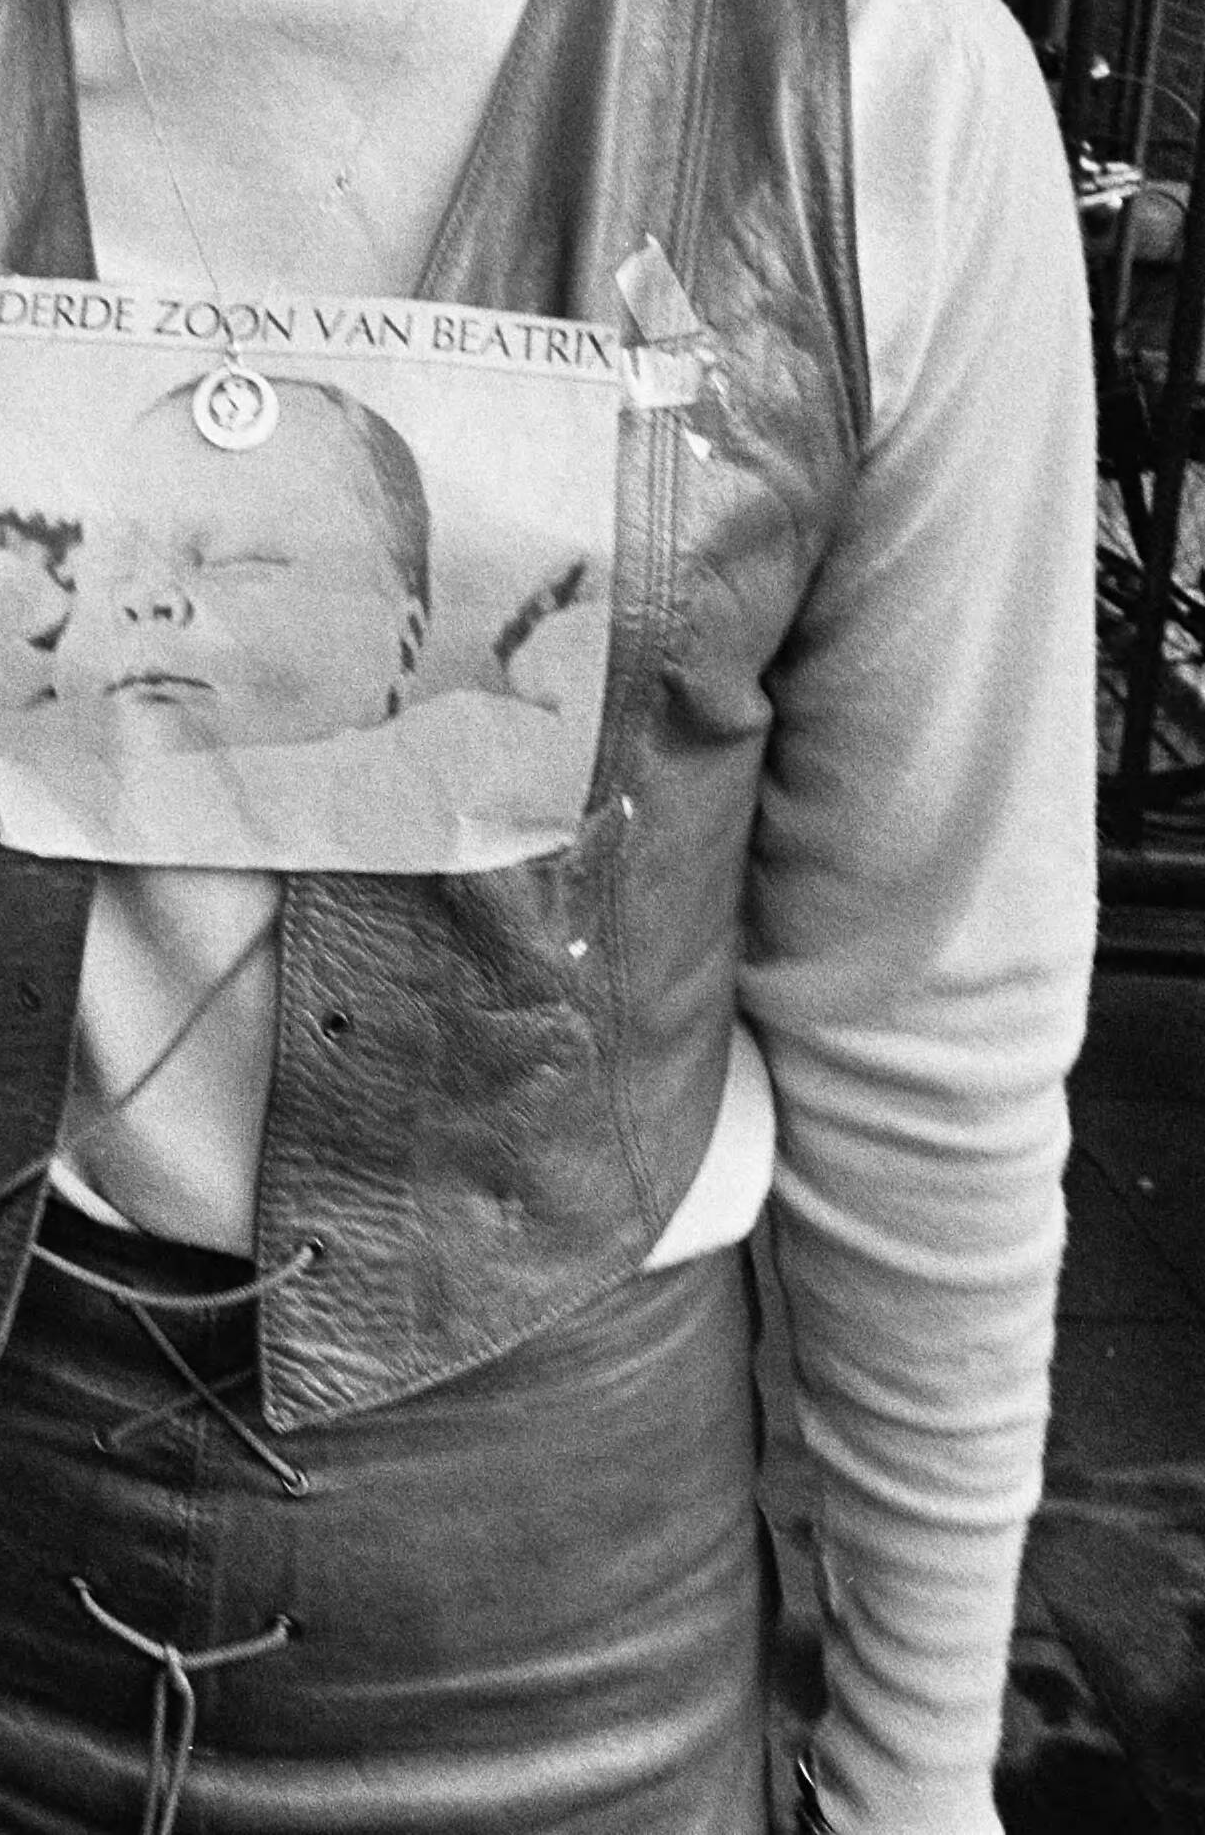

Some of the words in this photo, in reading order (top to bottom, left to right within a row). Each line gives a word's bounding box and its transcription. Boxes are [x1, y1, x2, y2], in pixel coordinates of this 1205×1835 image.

[152, 300, 297, 344] ZOON
[312, 307, 415, 348] VAN
[432, 315, 615, 369] BEATRIX
